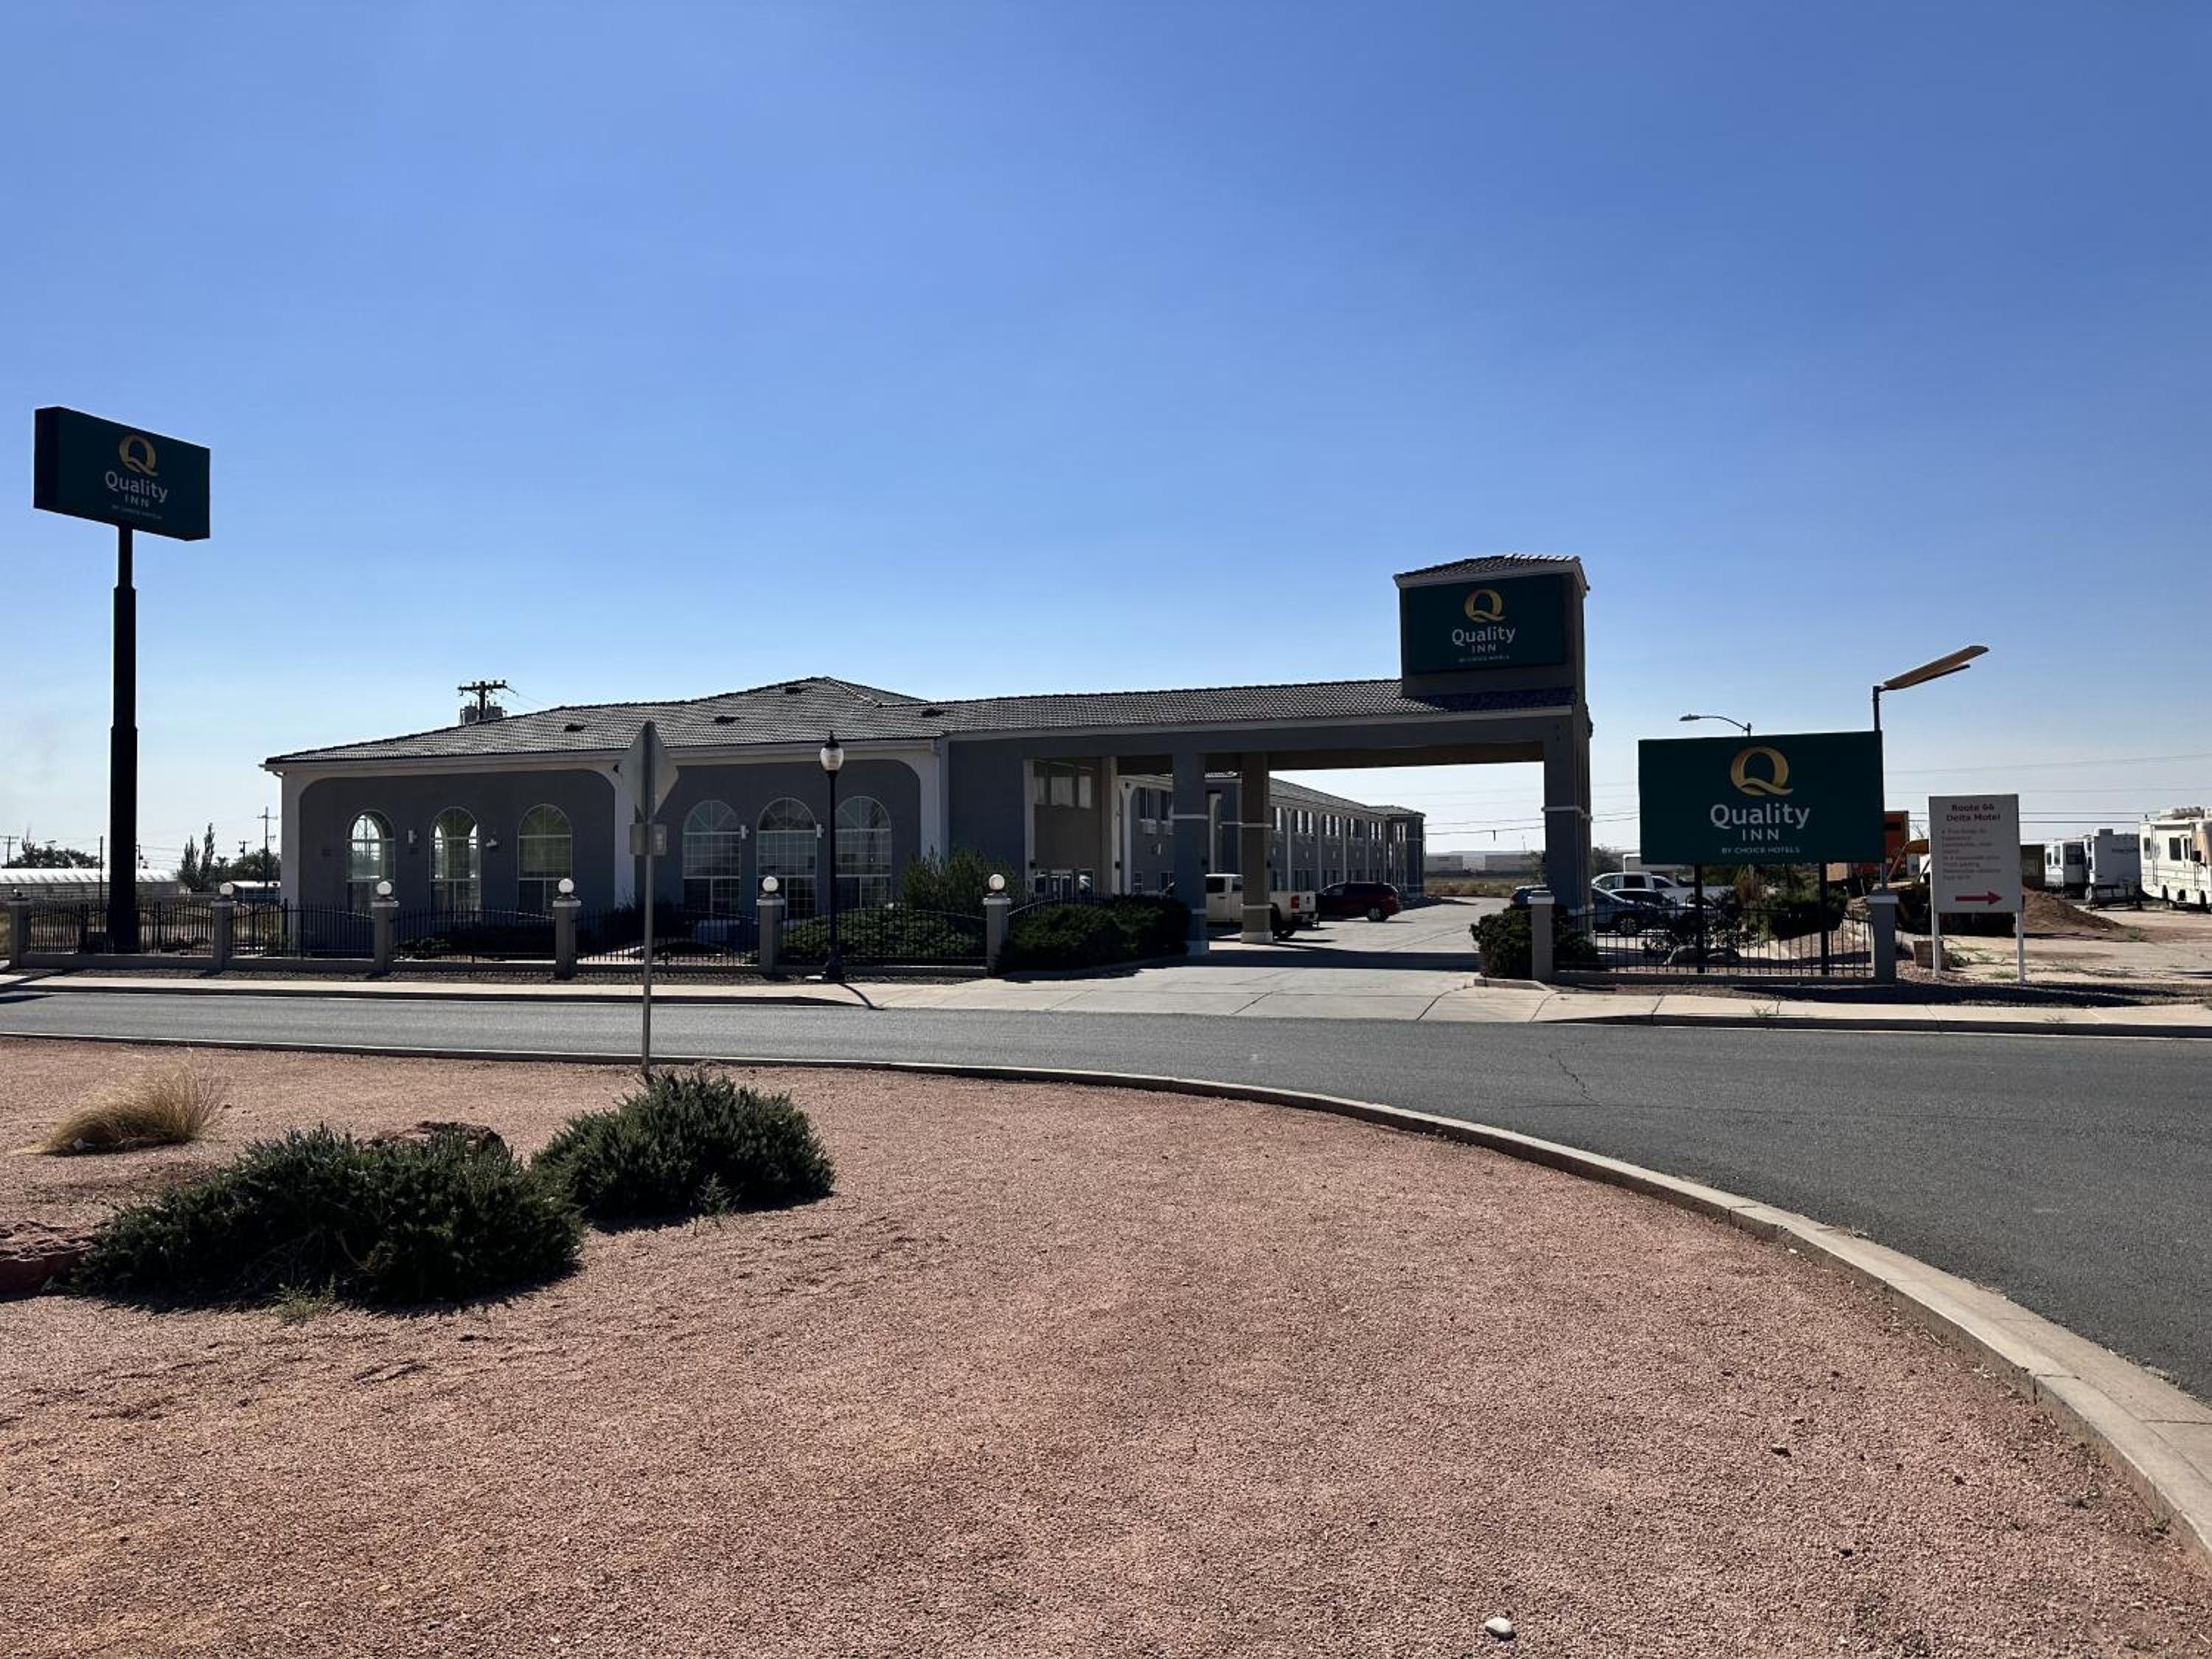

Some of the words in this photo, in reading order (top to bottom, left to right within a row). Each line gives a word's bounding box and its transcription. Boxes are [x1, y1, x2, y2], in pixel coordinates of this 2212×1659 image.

[118, 434, 159, 476] Q
[105, 470, 168, 503] Quality
[125, 494, 150, 507] INN
[1464, 589, 1506, 623] Q
[1451, 626, 1516, 646] Quality
[1471, 644, 1497, 654] INN
[1730, 745, 1794, 796] Q
[1710, 803, 1810, 830] Quality
[1946, 814, 1971, 822] Delta
[1974, 813, 2000, 821] Motel
[1742, 828, 1780, 842] INN
[1767, 846, 1801, 854] HOTELS
